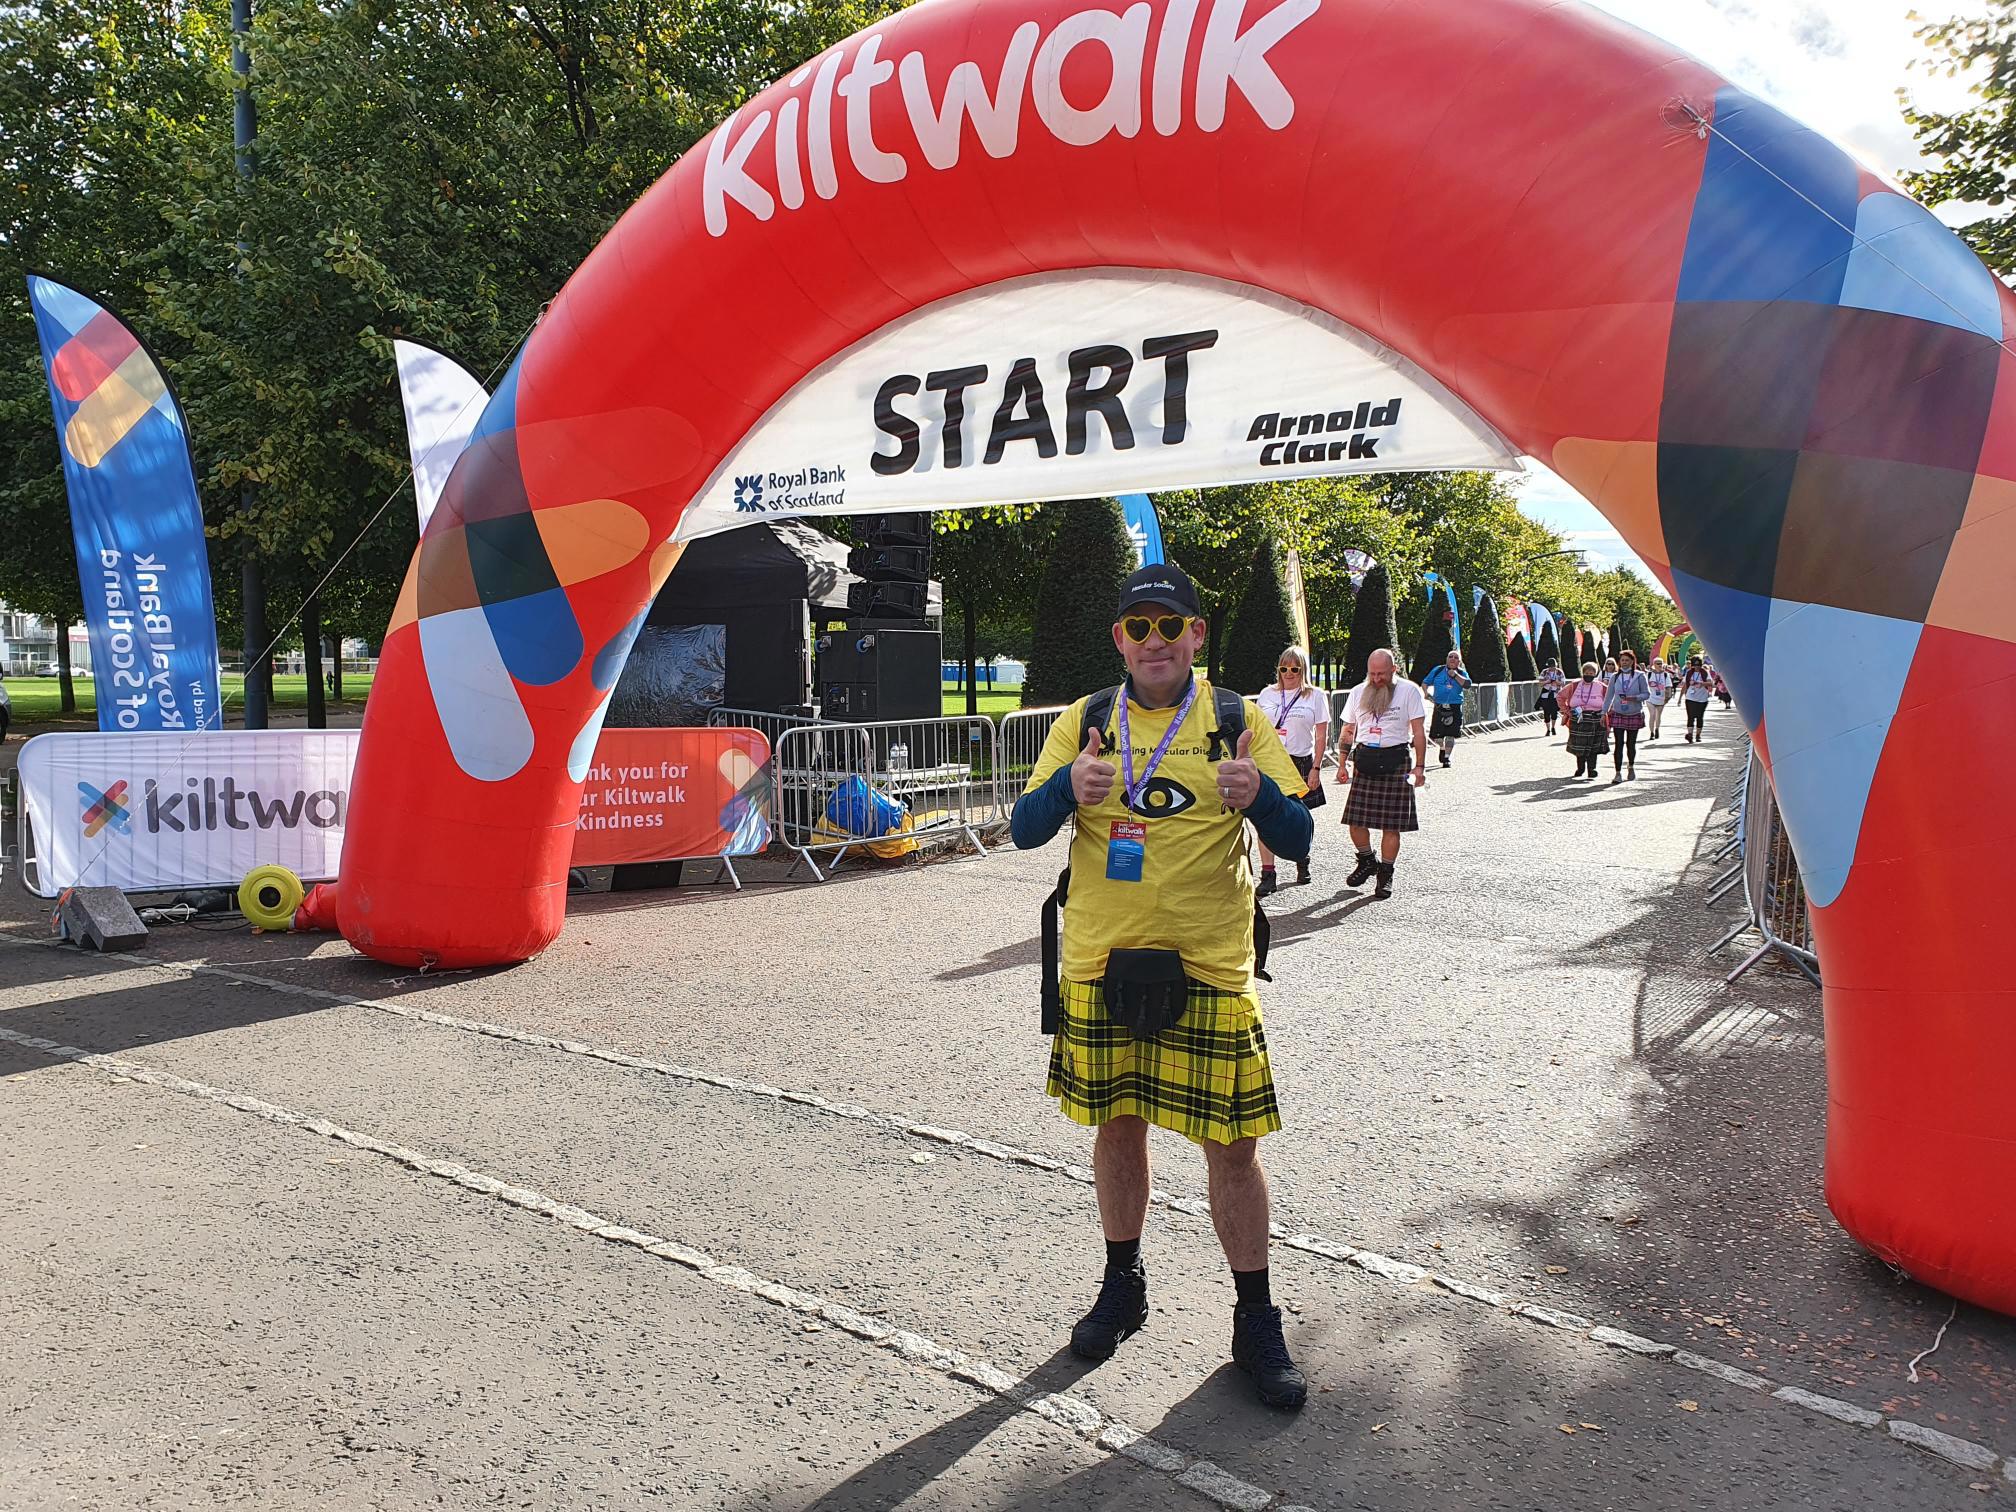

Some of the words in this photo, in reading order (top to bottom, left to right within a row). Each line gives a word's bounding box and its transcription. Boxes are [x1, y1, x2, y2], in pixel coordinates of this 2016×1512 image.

[702, 0, 1323, 238] kiltwalk
[870, 329, 1219, 477] START
[1246, 397, 1403, 441] Arnold
[1259, 433, 1379, 467] Clark
[768, 468, 807, 492] Royal
[809, 464, 847, 485] Bank
[768, 494, 784, 511] of
[785, 488, 846, 508] Scotland
[1149, 746, 1190, 756] Mcular
[618, 766, 654, 785] you
[660, 761, 689, 779] for
[605, 785, 686, 806] Kiltwalk
[576, 811, 664, 831] Kindness
